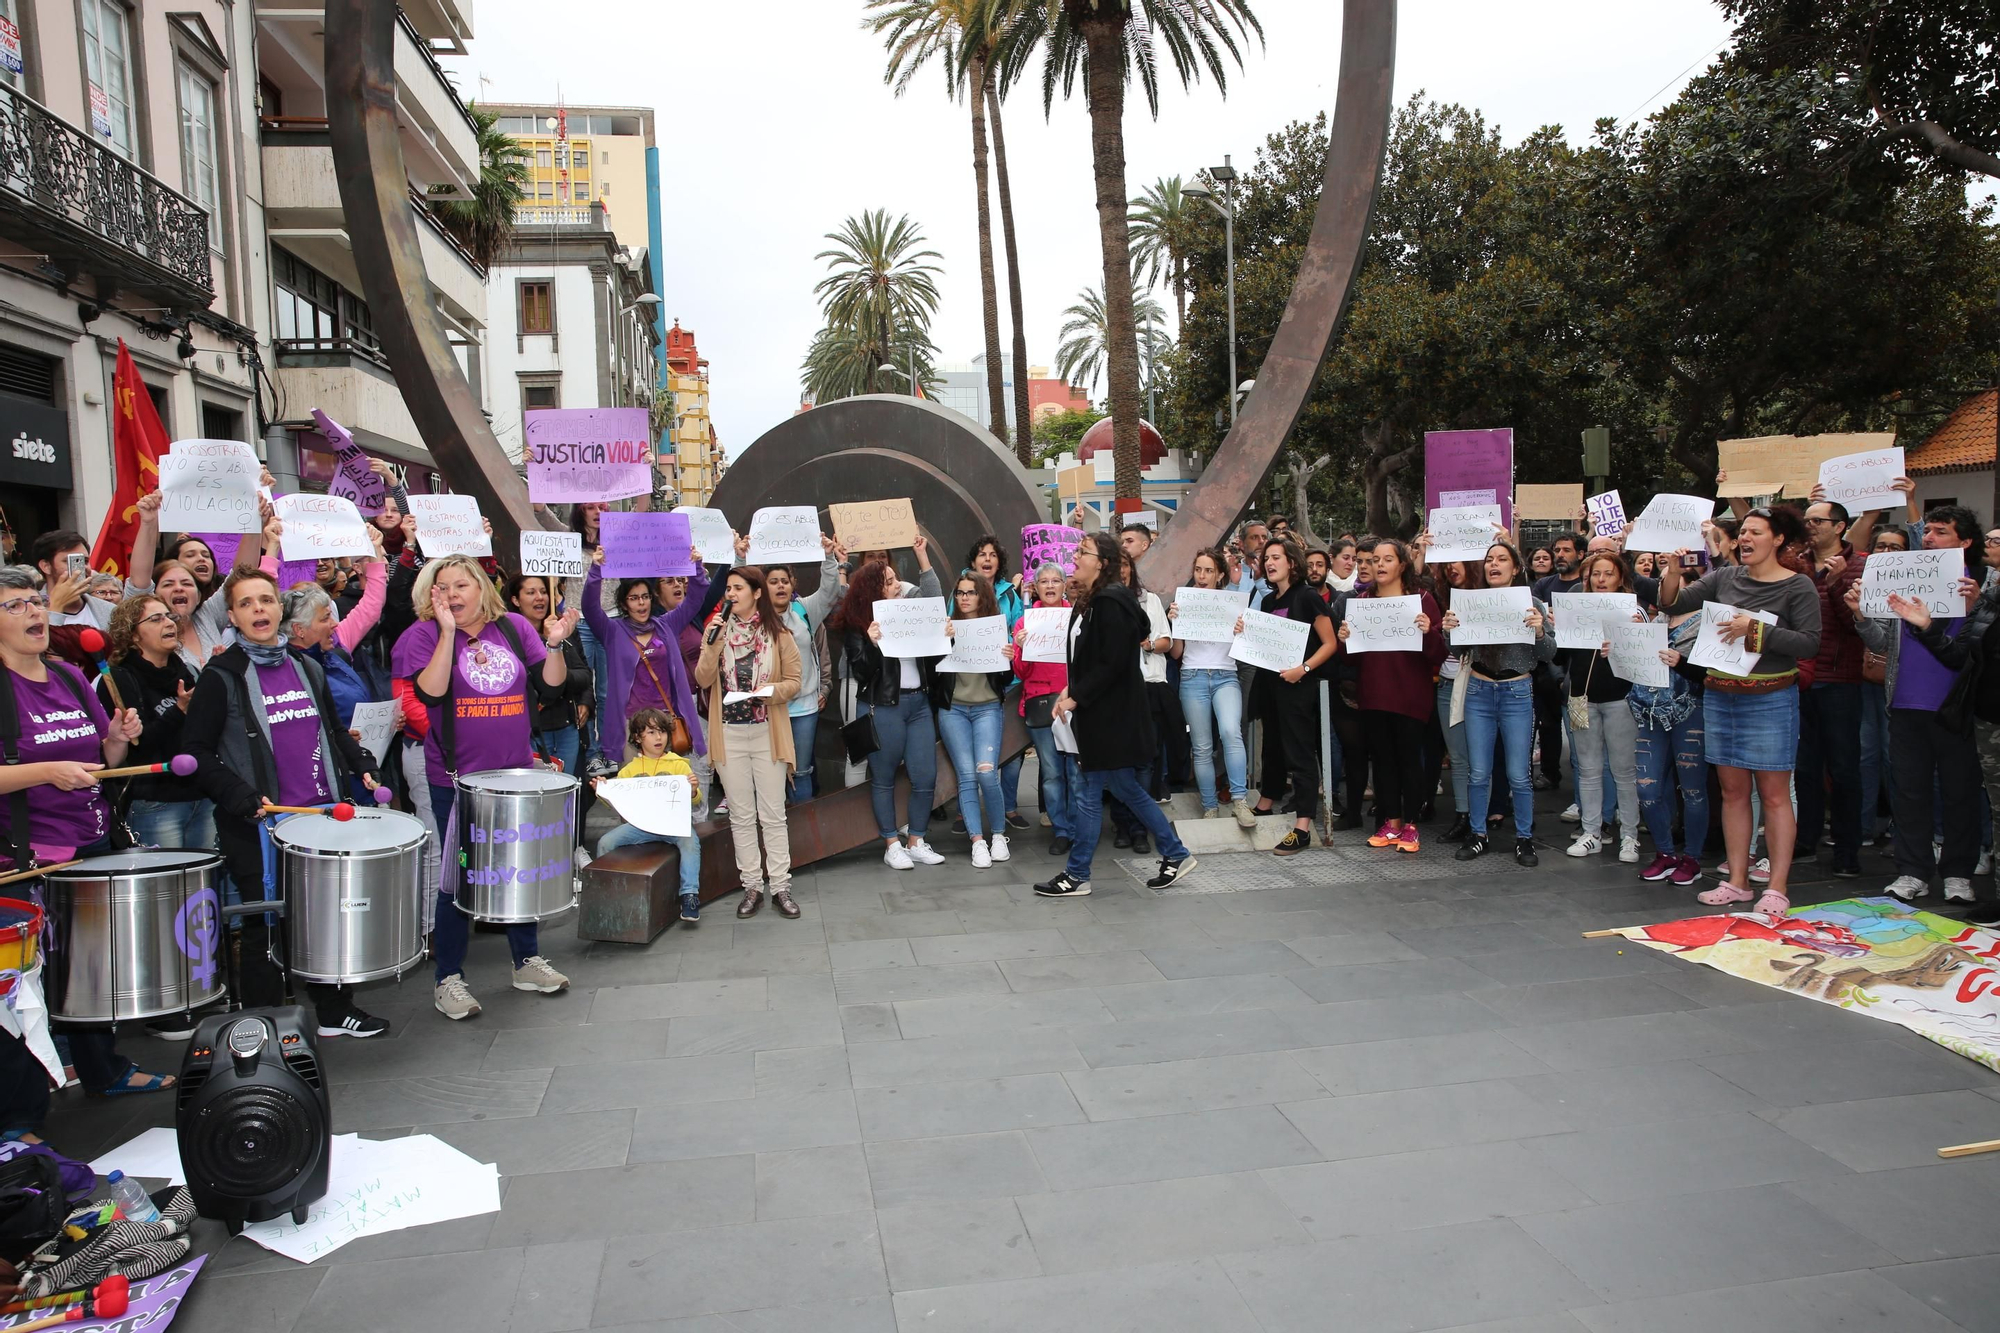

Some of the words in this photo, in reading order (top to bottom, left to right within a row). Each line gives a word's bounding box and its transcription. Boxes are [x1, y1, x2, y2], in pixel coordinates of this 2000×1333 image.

[12, 432, 56, 463] siete
[180, 444, 250, 457] NOSOTRAS
[606, 439, 650, 463] VIOLA
[163, 456, 188, 471] NO
[197, 460, 218, 473] ES
[1823, 465, 1840, 475] NO
[195, 476, 223, 489] ES
[162, 490, 255, 513] VIOLACIÓN
[1593, 494, 1613, 508] YO
[428, 513, 469, 523] ESTAMOS
[1453, 513, 1484, 521] TOCAN
[1606, 505, 1623, 520] TE
[603, 518, 640, 532] ABUSO
[1597, 519, 1626, 536] CREO
[1656, 518, 1697, 537] MANADA
[421, 527, 463, 538] NOSOTRAS
[524, 534, 544, 546] AQUÍ
[564, 537, 578, 548] TU
[1460, 539, 1491, 549] TODAS
[536, 547, 566, 558] MANADA
[1865, 556, 1904, 570] ELLOS
[1914, 552, 1946, 564] SON
[1876, 566, 1939, 581] MANADA
[1178, 592, 1209, 601] FRENTE
[1225, 595, 1239, 603] LAS
[1863, 583, 1935, 601] NOSOTRAS
[895, 604, 925, 612] TOCAN
[1453, 592, 1509, 612] NINGUNA
[1578, 598, 1594, 609] ES
[1597, 598, 1636, 610] ABUSO
[904, 616, 923, 625] NOS
[1365, 615, 1382, 624] YO
[1466, 609, 1527, 625] AGRESIÓN
[1576, 615, 1596, 625] ES
[1178, 621, 1234, 629] AUTODEFEN
[890, 631, 917, 639] TODAS
[1357, 630, 1377, 640] TE
[1382, 626, 1416, 637] CREO
[1459, 627, 1480, 641] SIN
[1617, 626, 1655, 639] TOCAN
[962, 643, 1001, 652] MANADA
[1026, 632, 1067, 650] MATX
[1622, 639, 1645, 651] UNA
[263, 694, 275, 706] la
[357, 708, 375, 720] NO
[457, 706, 466, 717] SE
[467, 705, 488, 717] PARA
[491, 705, 499, 717] EL
[501, 702, 524, 716] MUNDO
[29, 711, 44, 724] la
[470, 823, 487, 843] la
[494, 820, 565, 844] soRora
